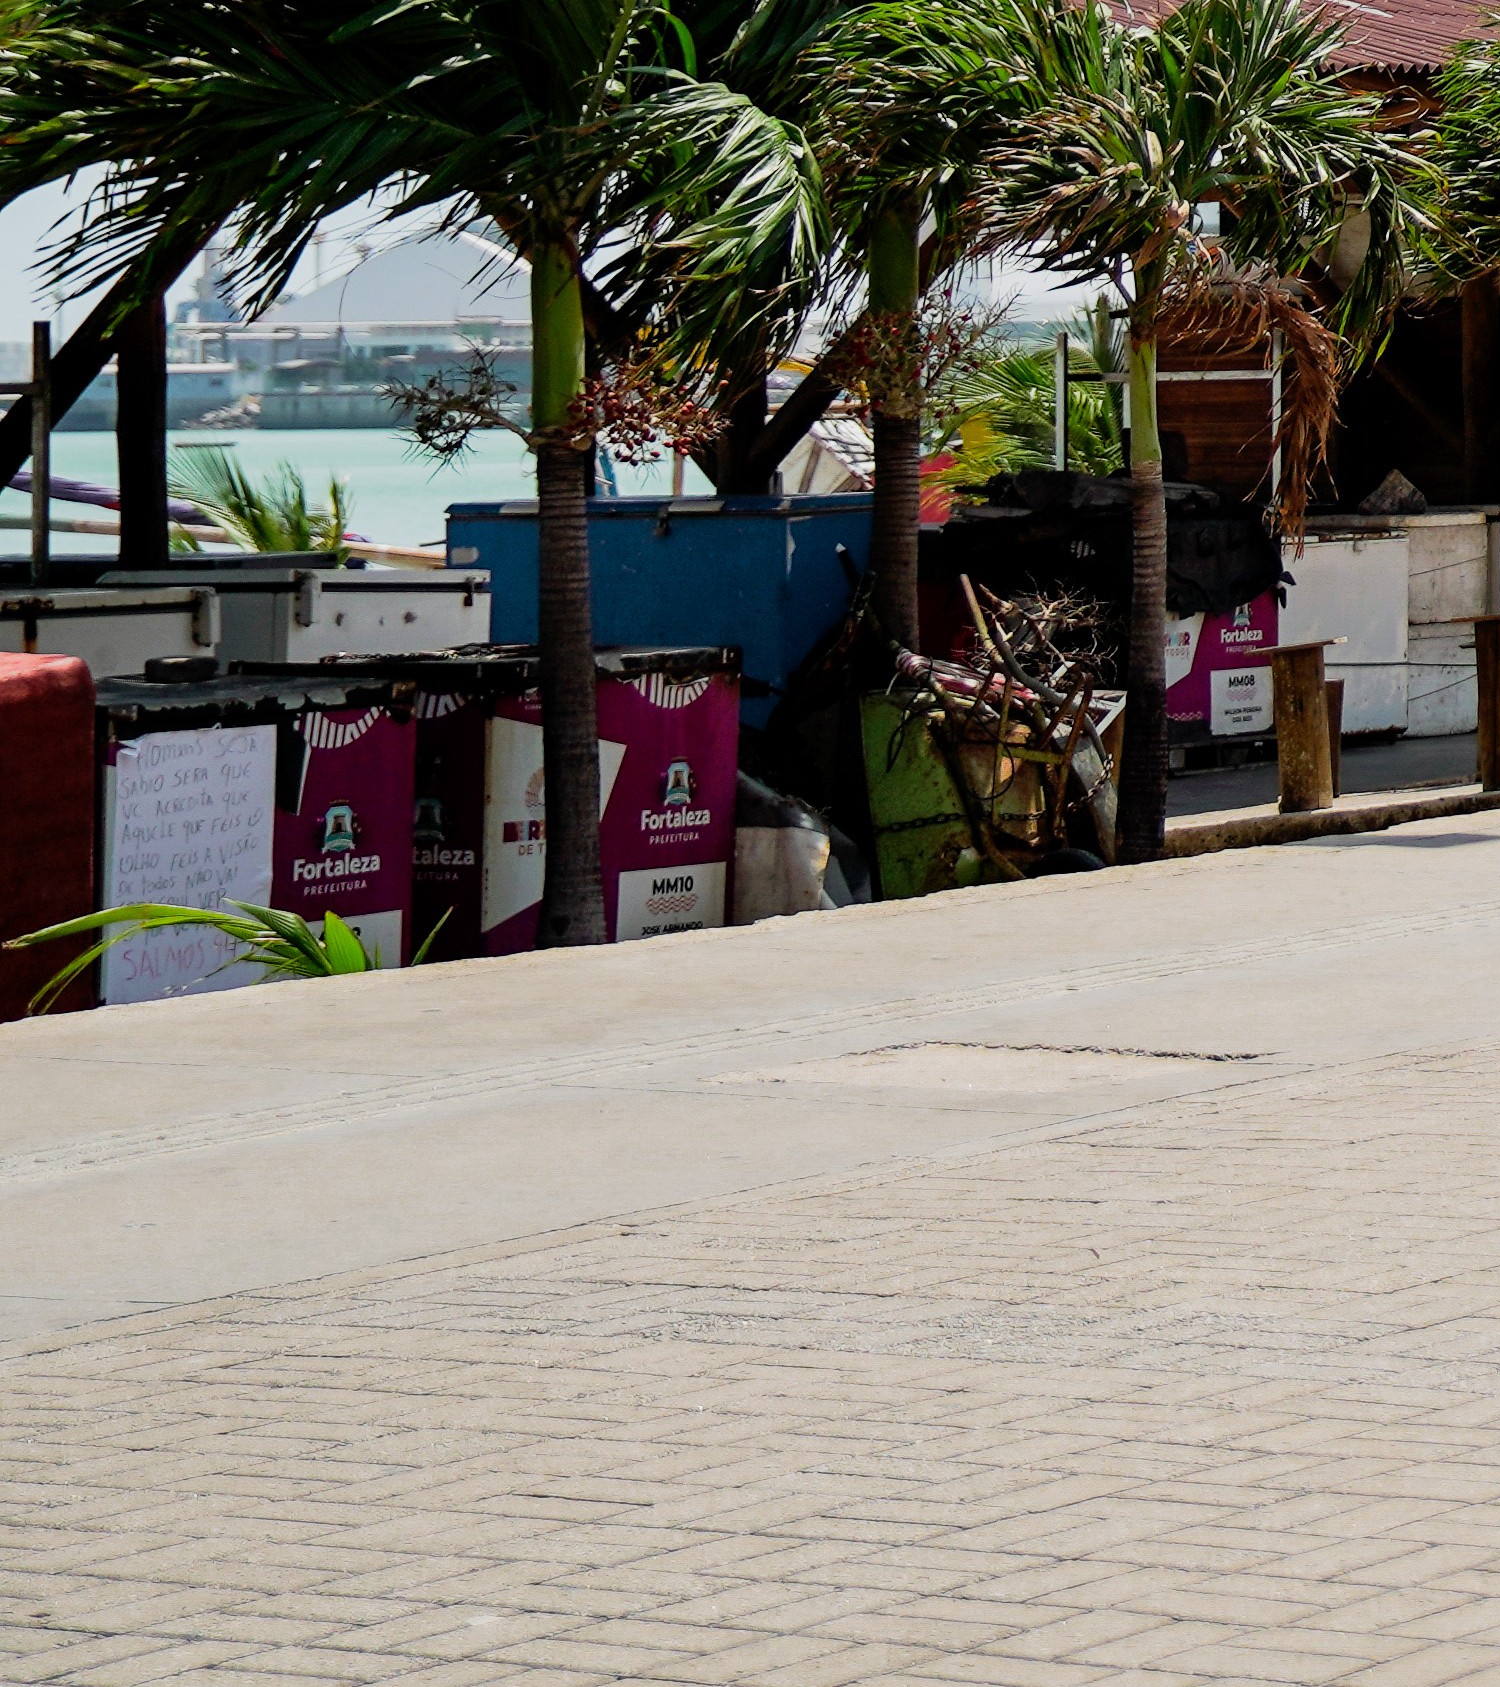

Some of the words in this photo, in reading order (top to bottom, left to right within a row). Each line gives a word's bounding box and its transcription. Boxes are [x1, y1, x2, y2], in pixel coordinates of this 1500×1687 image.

[1220, 626, 1263, 644] Fortaleza
[641, 806, 711, 831] Fortaleza
[649, 831, 700, 845] PREFEITURA
[413, 843, 475, 866] taleza
[518, 843, 533, 856] DE
[293, 852, 381, 882] Fortaleza
[416, 871, 460, 881] EITURA
[303, 879, 368, 897] PREFEITURA
[652, 875, 694, 896] MM10
